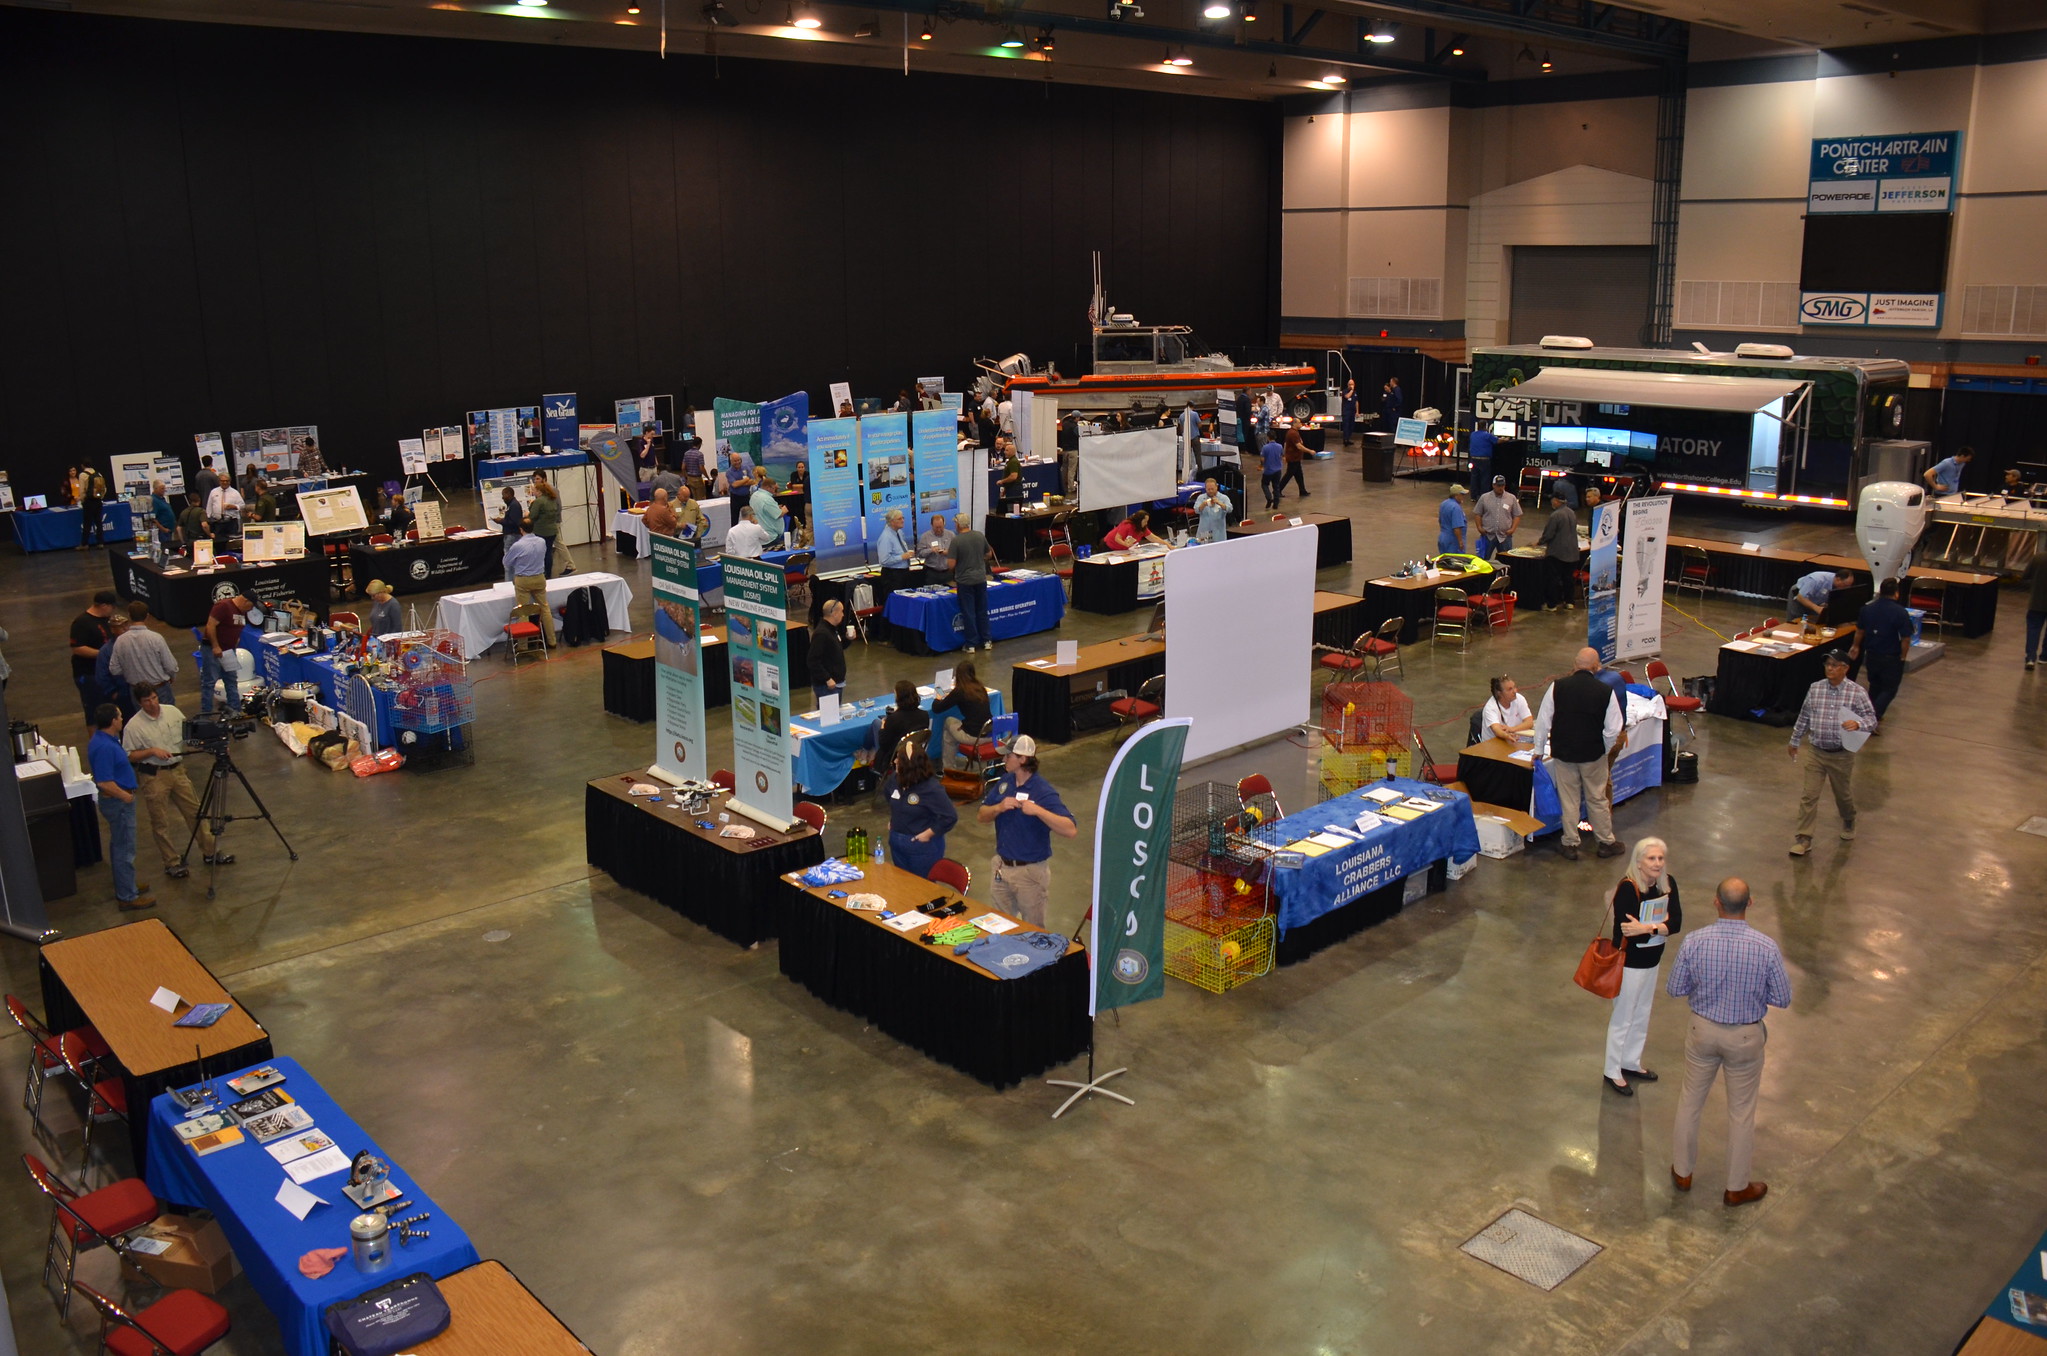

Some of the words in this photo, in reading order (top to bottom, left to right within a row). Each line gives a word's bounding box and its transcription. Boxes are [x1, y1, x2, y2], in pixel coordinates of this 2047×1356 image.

[1820, 138, 1948, 158] PONTCHARTRAIN
[1833, 158, 1889, 175] CENTER
[1811, 193, 1871, 201] POWERADE
[1881, 189, 1946, 199] JEFFERSON
[1813, 300, 1858, 317] SMG
[546, 407, 558, 418] Sea
[558, 406, 576, 417] Grant
[721, 410, 746, 418] MANAGING
[722, 416, 760, 428] SUSTAINABLE
[722, 428, 742, 436] FISHING
[744, 426, 761, 434] FUTURE
[654, 543, 673, 555] LOUISIANA
[680, 551, 690, 560] SPILL
[654, 553, 676, 565] MANAGEMENT
[677, 559, 689, 569] SYSTEM
[724, 564, 754, 577] LOUISIANA
[754, 570, 763, 579] OIL
[764, 572, 779, 584] SPILL
[726, 576, 759, 589] MANAGEMENT
[760, 583, 778, 594] SYSTEM
[273, 589, 296, 598] Fisheries
[740, 601, 758, 611] ONLINE
[1335, 844, 1384, 876] LOUISIANA
[1343, 856, 1392, 886] CRABBERS
[1333, 875, 1379, 906] ALLIANCE
[1384, 865, 1401, 881] LLC
